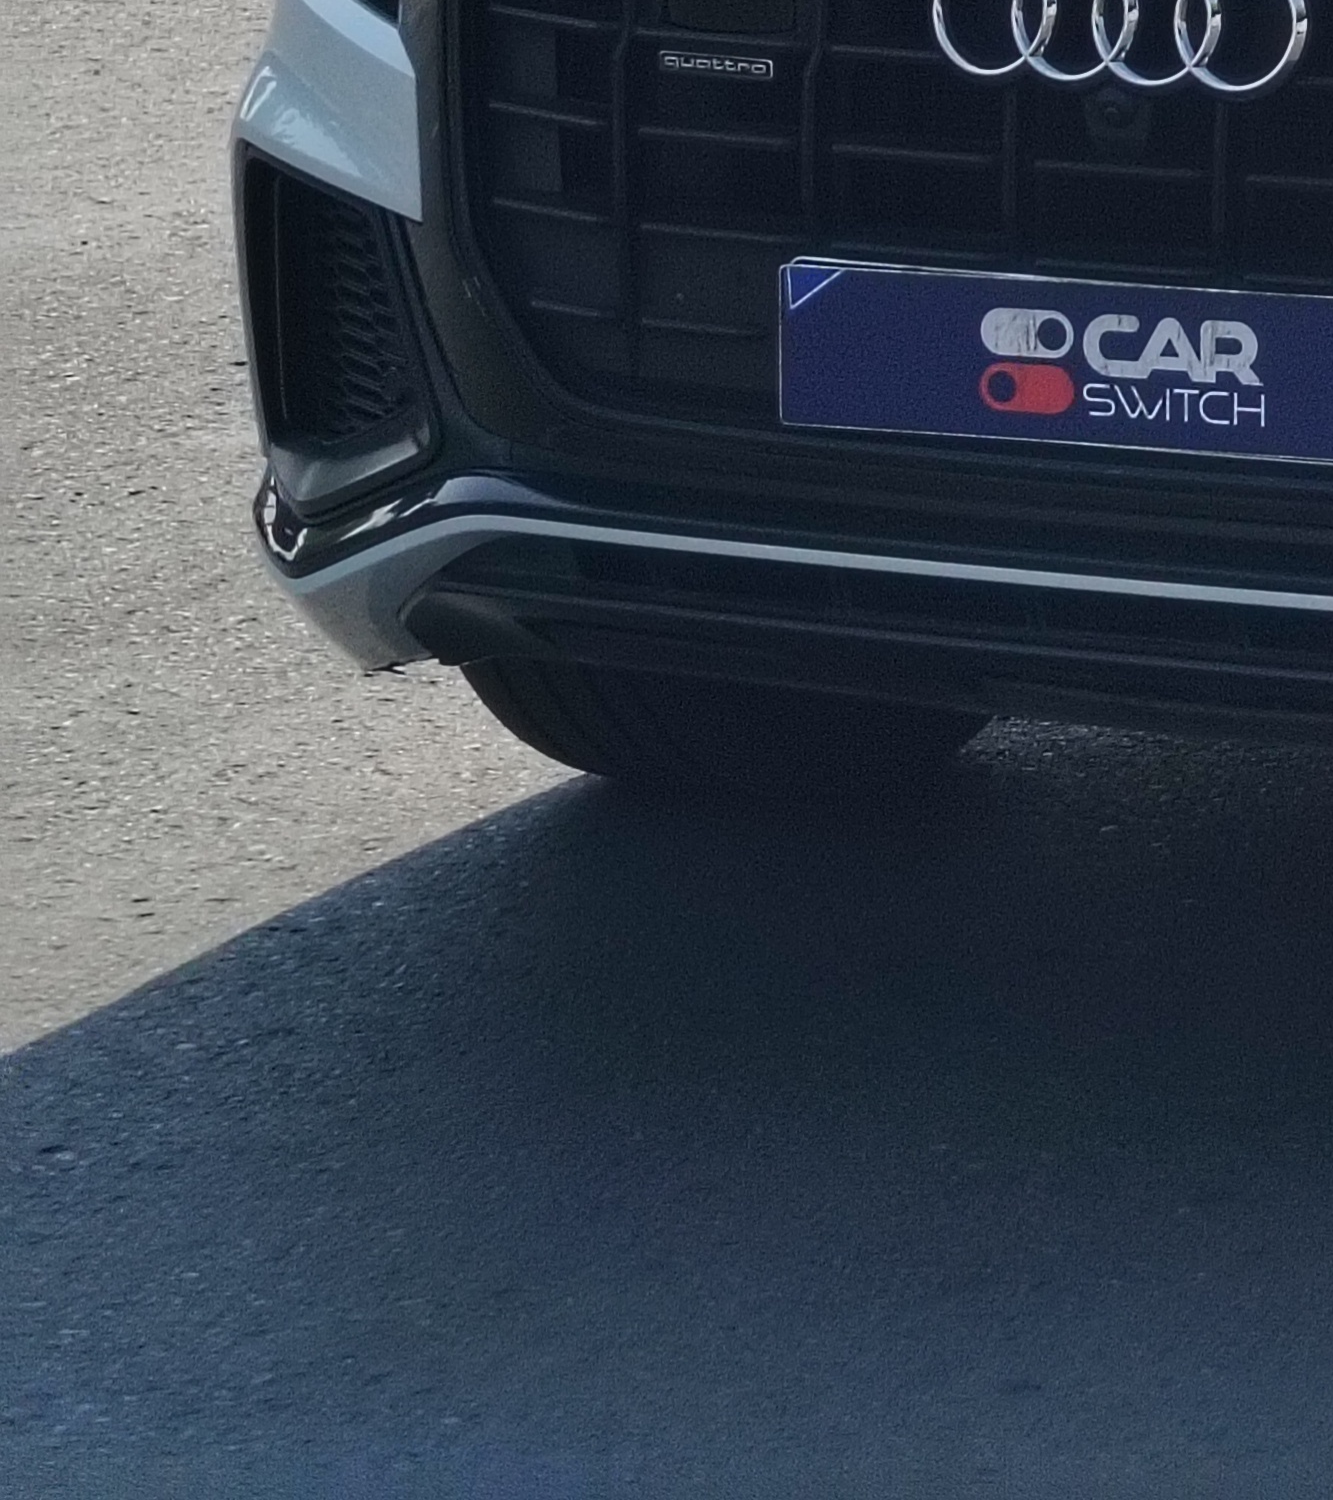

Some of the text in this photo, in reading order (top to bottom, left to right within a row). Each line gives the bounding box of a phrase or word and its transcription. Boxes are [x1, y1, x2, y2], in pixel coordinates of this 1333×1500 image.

[664, 55, 767, 75] quattro
[1082, 313, 1264, 386] CAR
[1082, 383, 1266, 428] SWITCH
